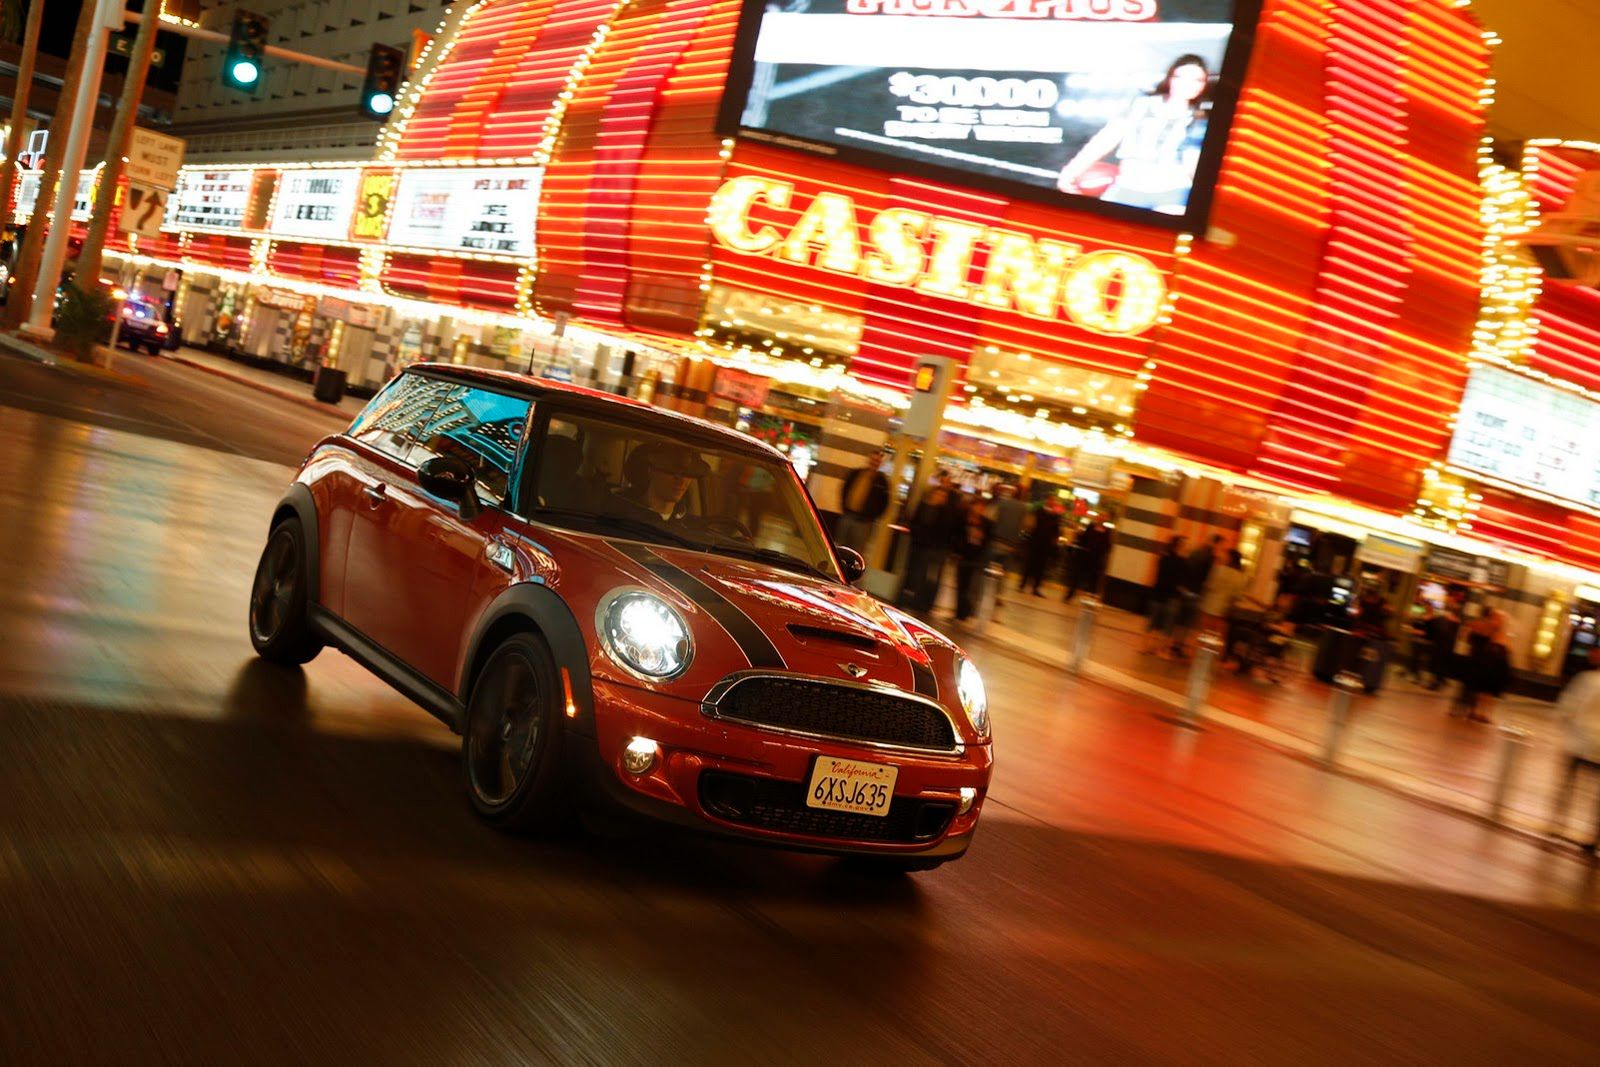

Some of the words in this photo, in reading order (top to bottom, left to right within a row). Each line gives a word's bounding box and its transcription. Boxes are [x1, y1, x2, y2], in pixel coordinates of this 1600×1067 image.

[142, 152, 169, 166] MUST
[709, 175, 1168, 336] CASINO
[832, 762, 880, 778] California
[814, 777, 888, 808] 6XSJ635
